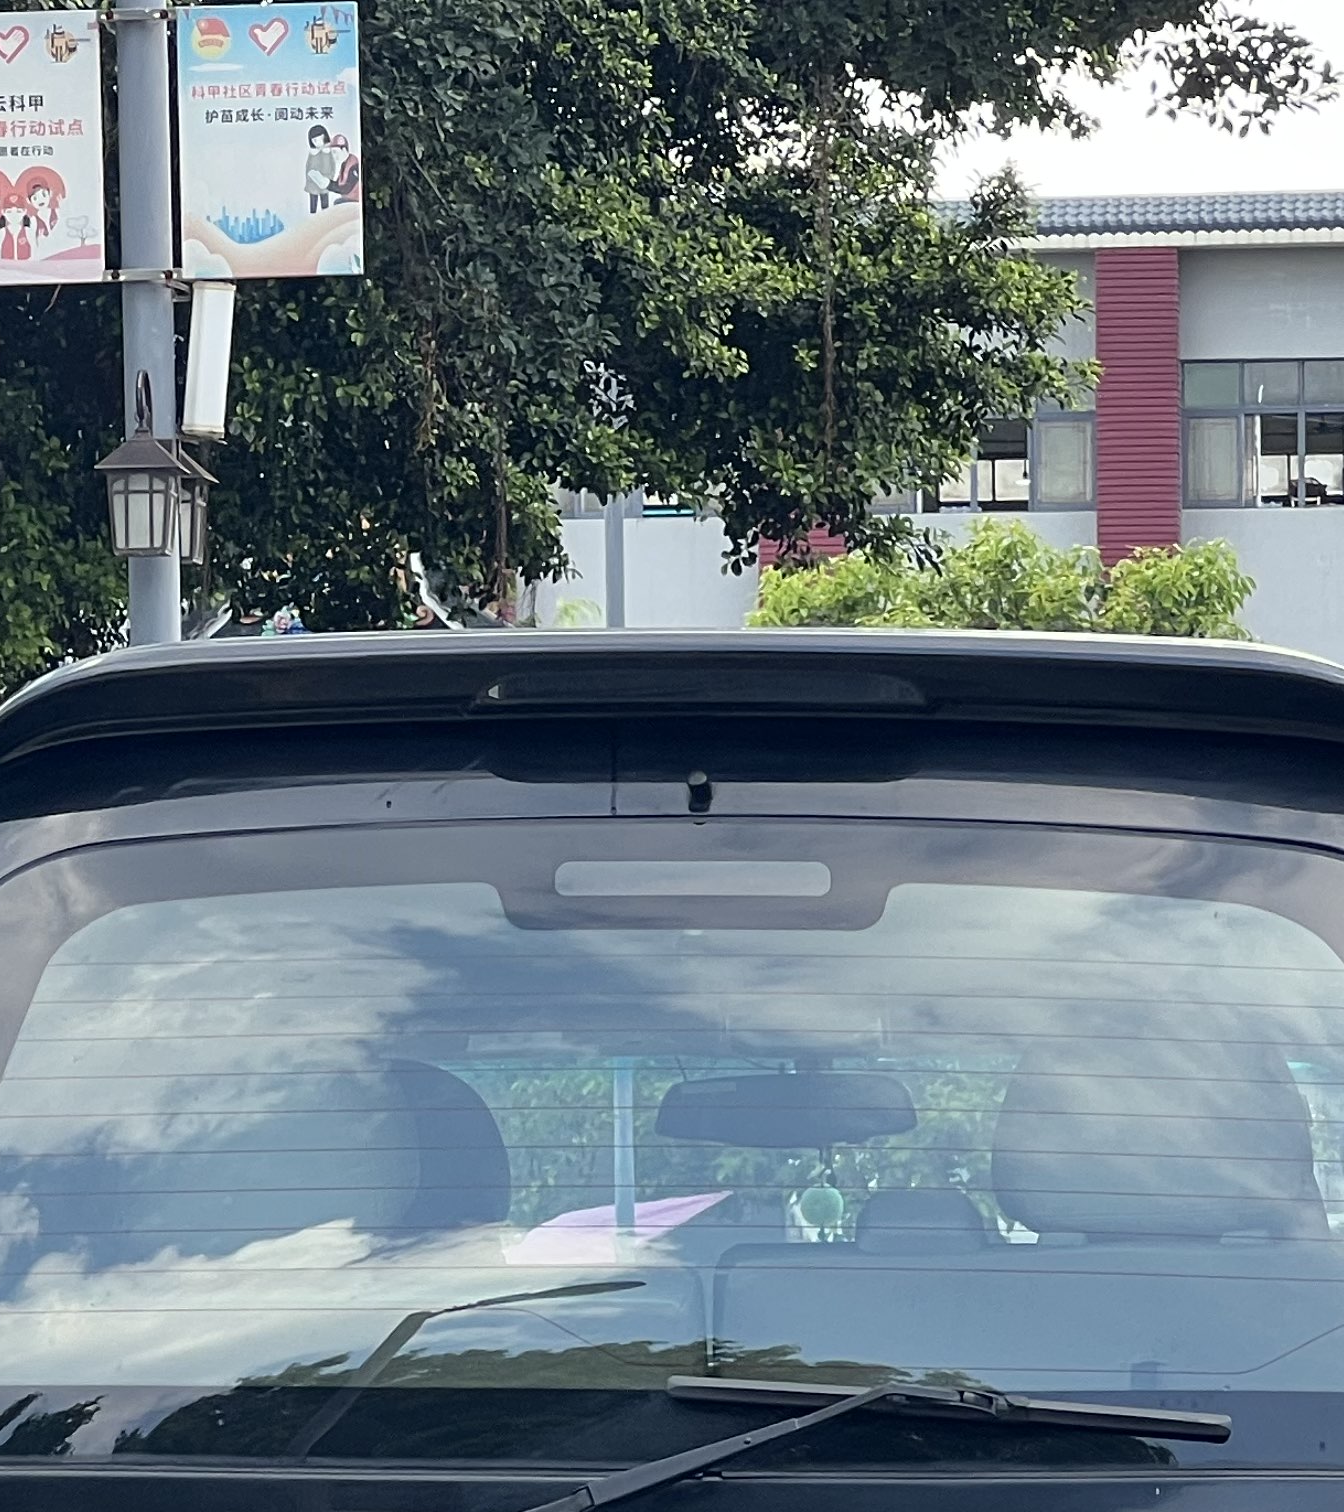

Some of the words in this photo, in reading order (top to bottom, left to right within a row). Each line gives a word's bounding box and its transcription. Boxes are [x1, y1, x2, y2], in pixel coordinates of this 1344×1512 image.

[191, 81, 347, 99] 科甲社区青春行动试点
